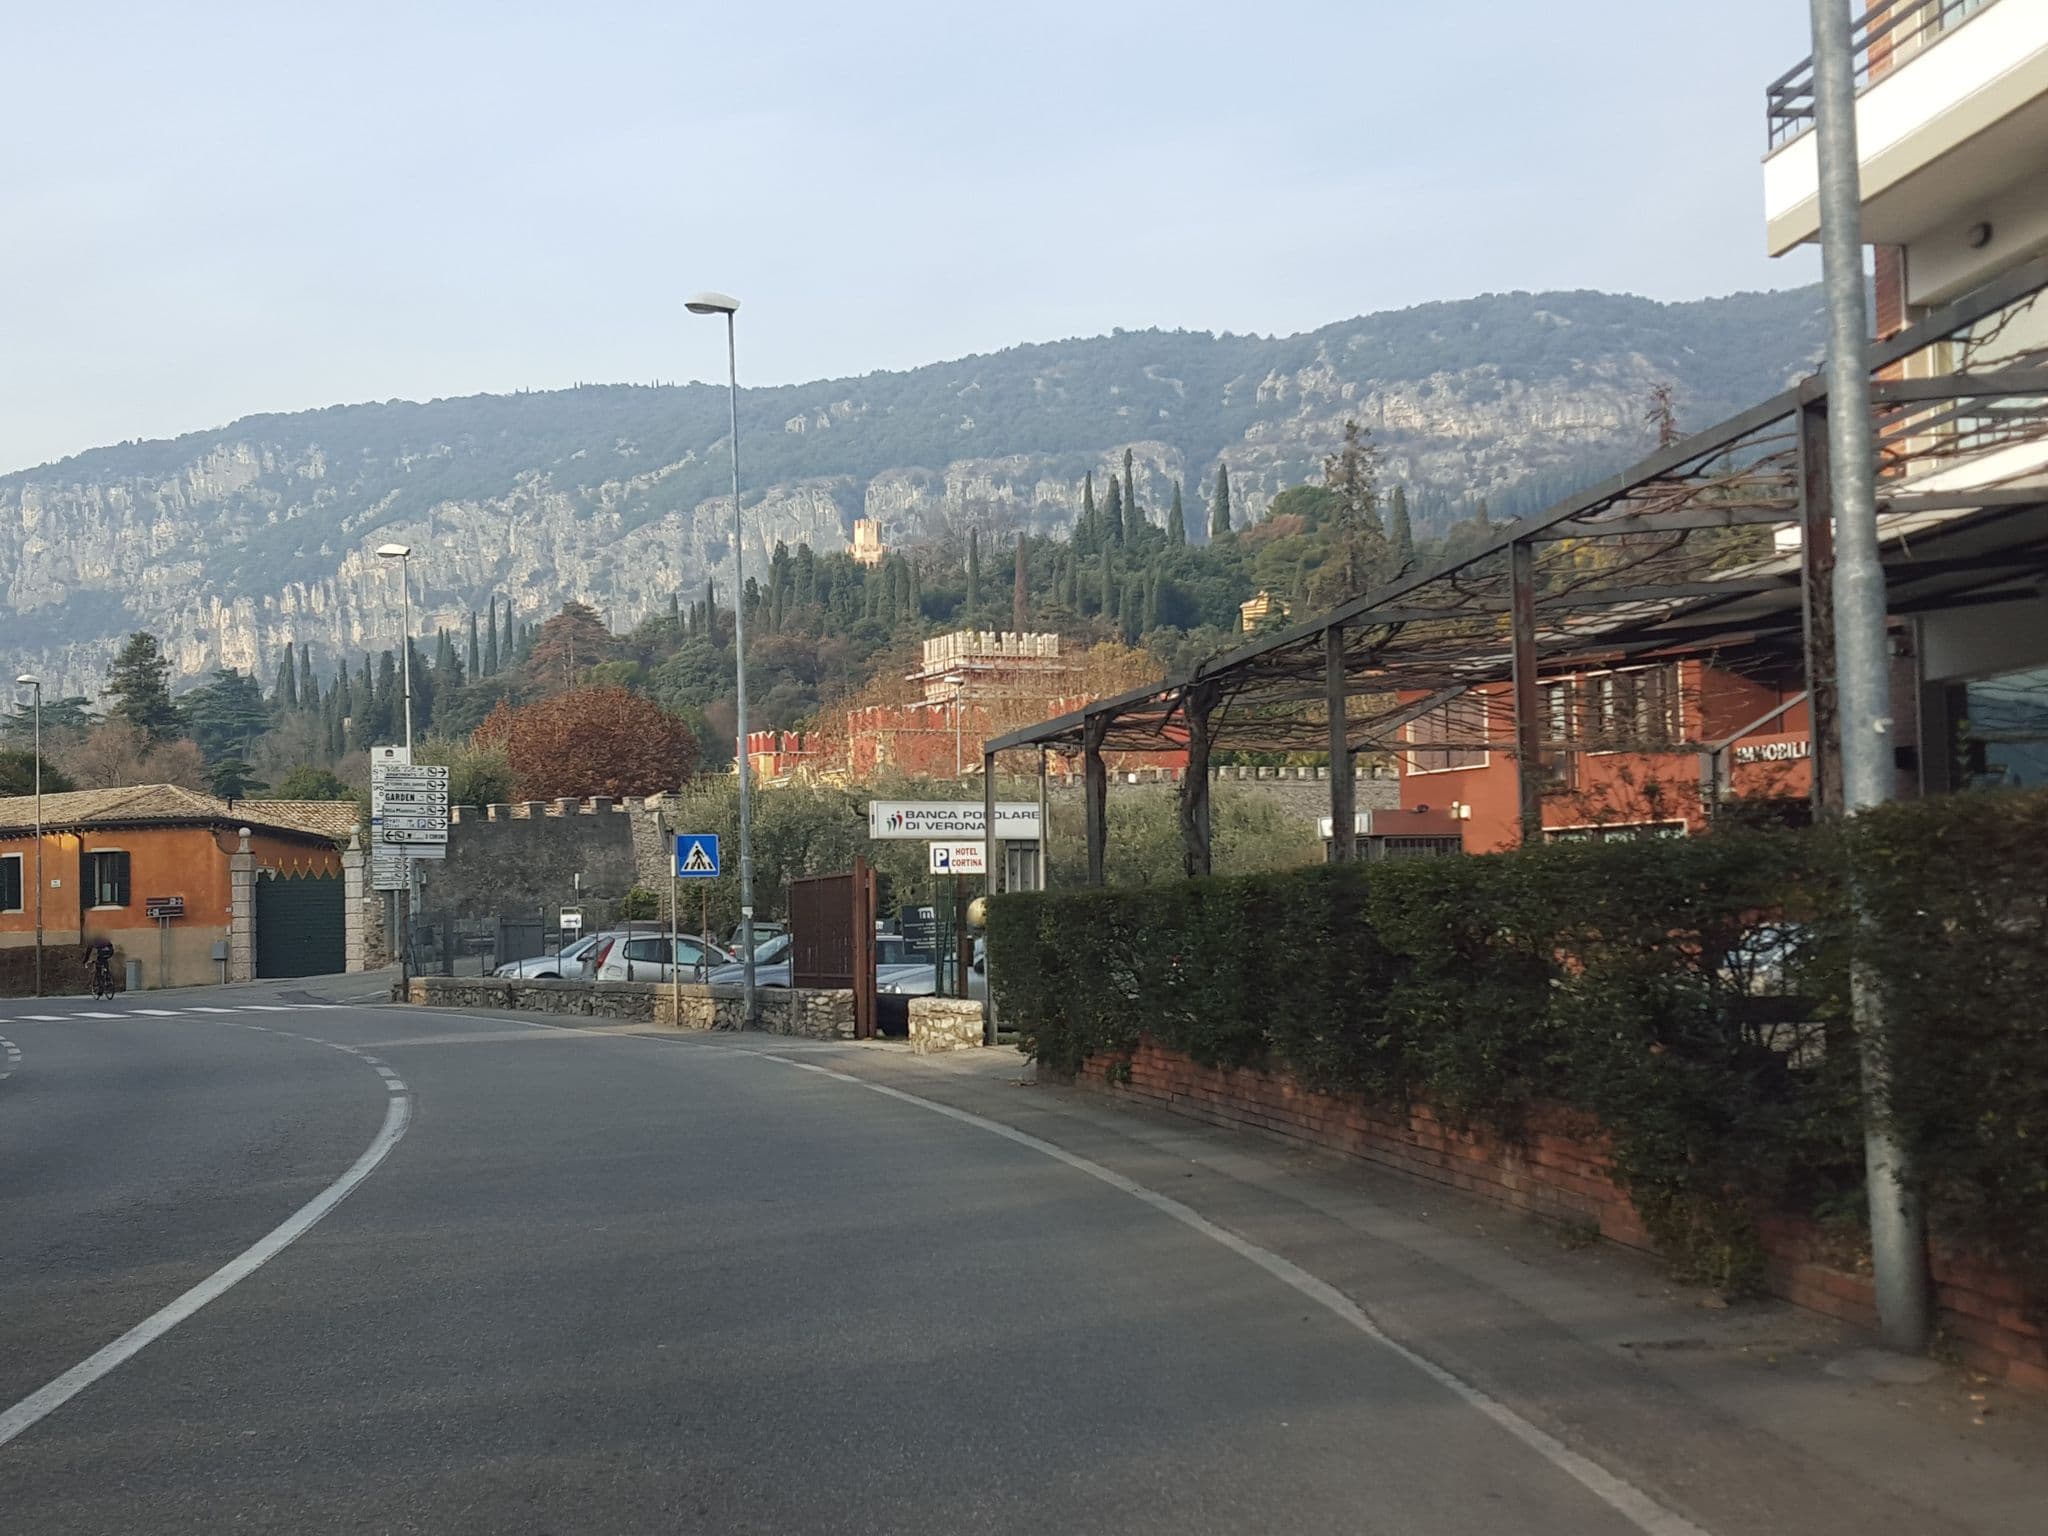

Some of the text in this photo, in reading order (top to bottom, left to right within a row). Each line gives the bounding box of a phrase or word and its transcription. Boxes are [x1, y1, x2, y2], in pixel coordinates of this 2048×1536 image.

[385, 793, 415, 801] GARDEN
[905, 811, 1040, 819] BANCA POOLARE
[905, 822, 986, 830] DI VERONA
[955, 848, 978, 856] HOTEL
[951, 859, 983, 867] CORTINA
